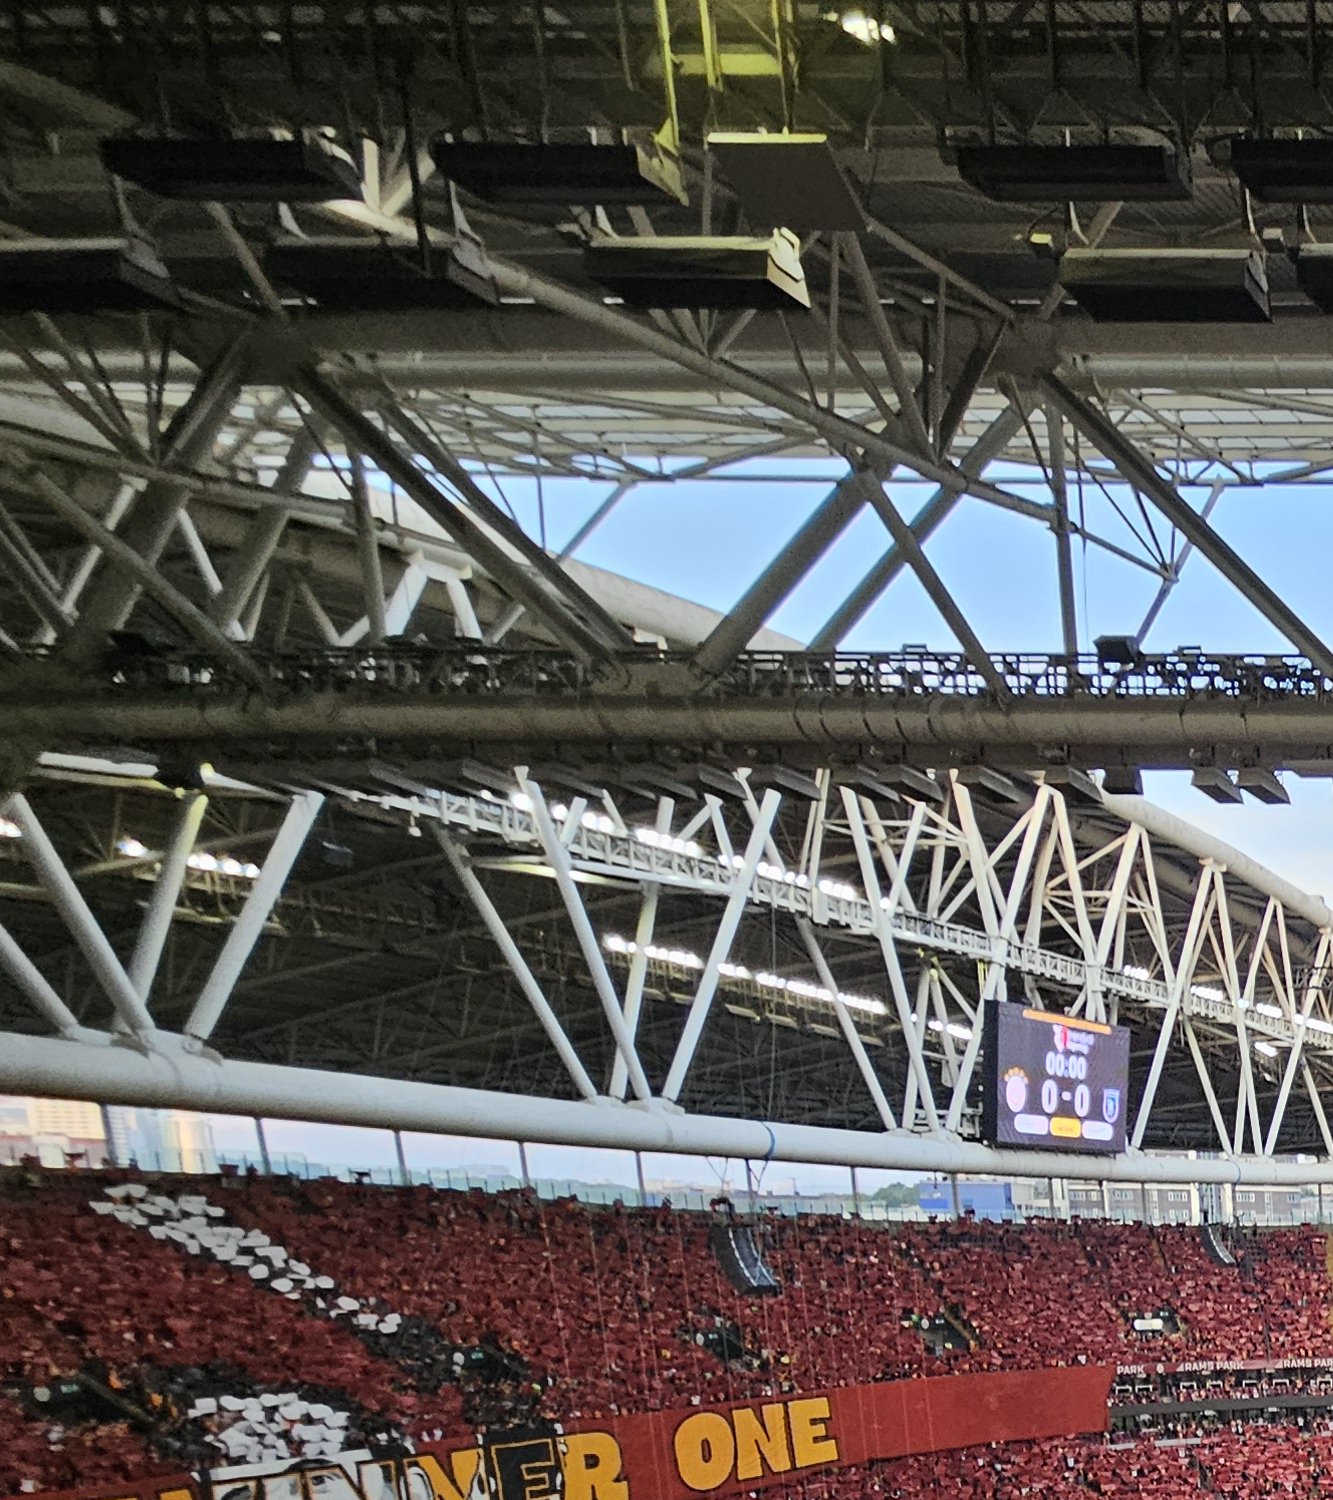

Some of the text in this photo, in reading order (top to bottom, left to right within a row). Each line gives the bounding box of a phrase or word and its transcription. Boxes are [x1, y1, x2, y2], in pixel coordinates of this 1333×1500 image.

[1045, 1051, 1087, 1080] 00:00
[1117, 1364, 1145, 1375] PARK
[1184, 1361, 1244, 1373] RAMS PARK
[1283, 1359, 1311, 1370] RAMS
[674, 1397, 840, 1491] ONE
